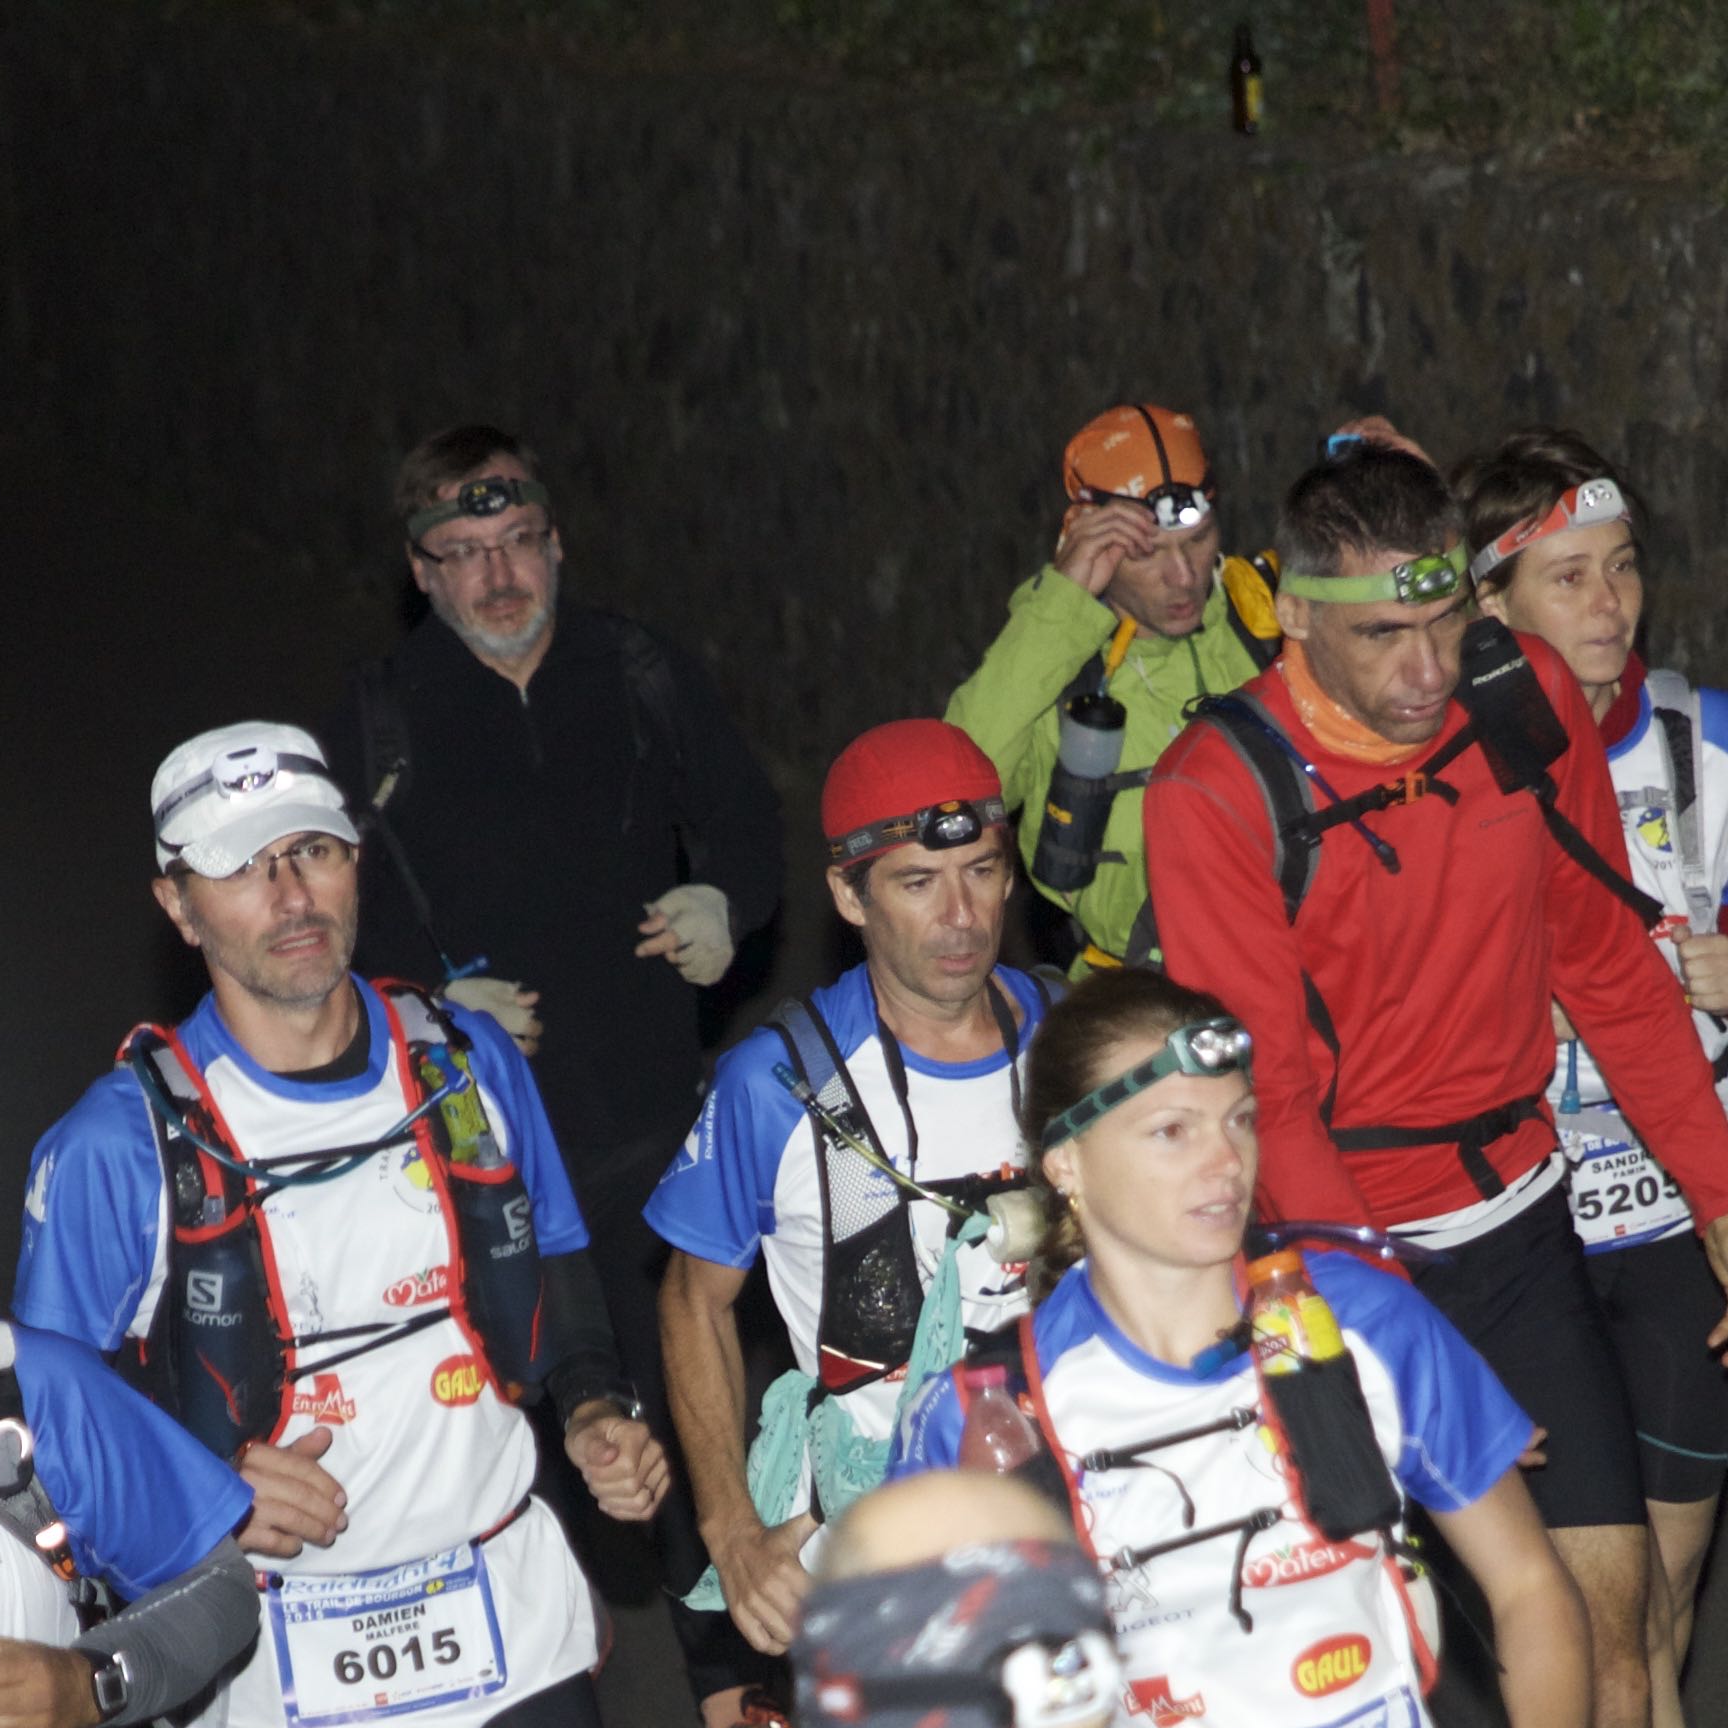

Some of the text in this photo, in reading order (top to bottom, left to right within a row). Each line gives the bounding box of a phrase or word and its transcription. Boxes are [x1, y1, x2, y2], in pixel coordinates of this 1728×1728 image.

[351, 1603, 428, 1633] DAMIEN
[364, 1620, 421, 1642] MALFERE
[332, 1626, 462, 1685] 6015
[1296, 1644, 1366, 1692] GAUL
